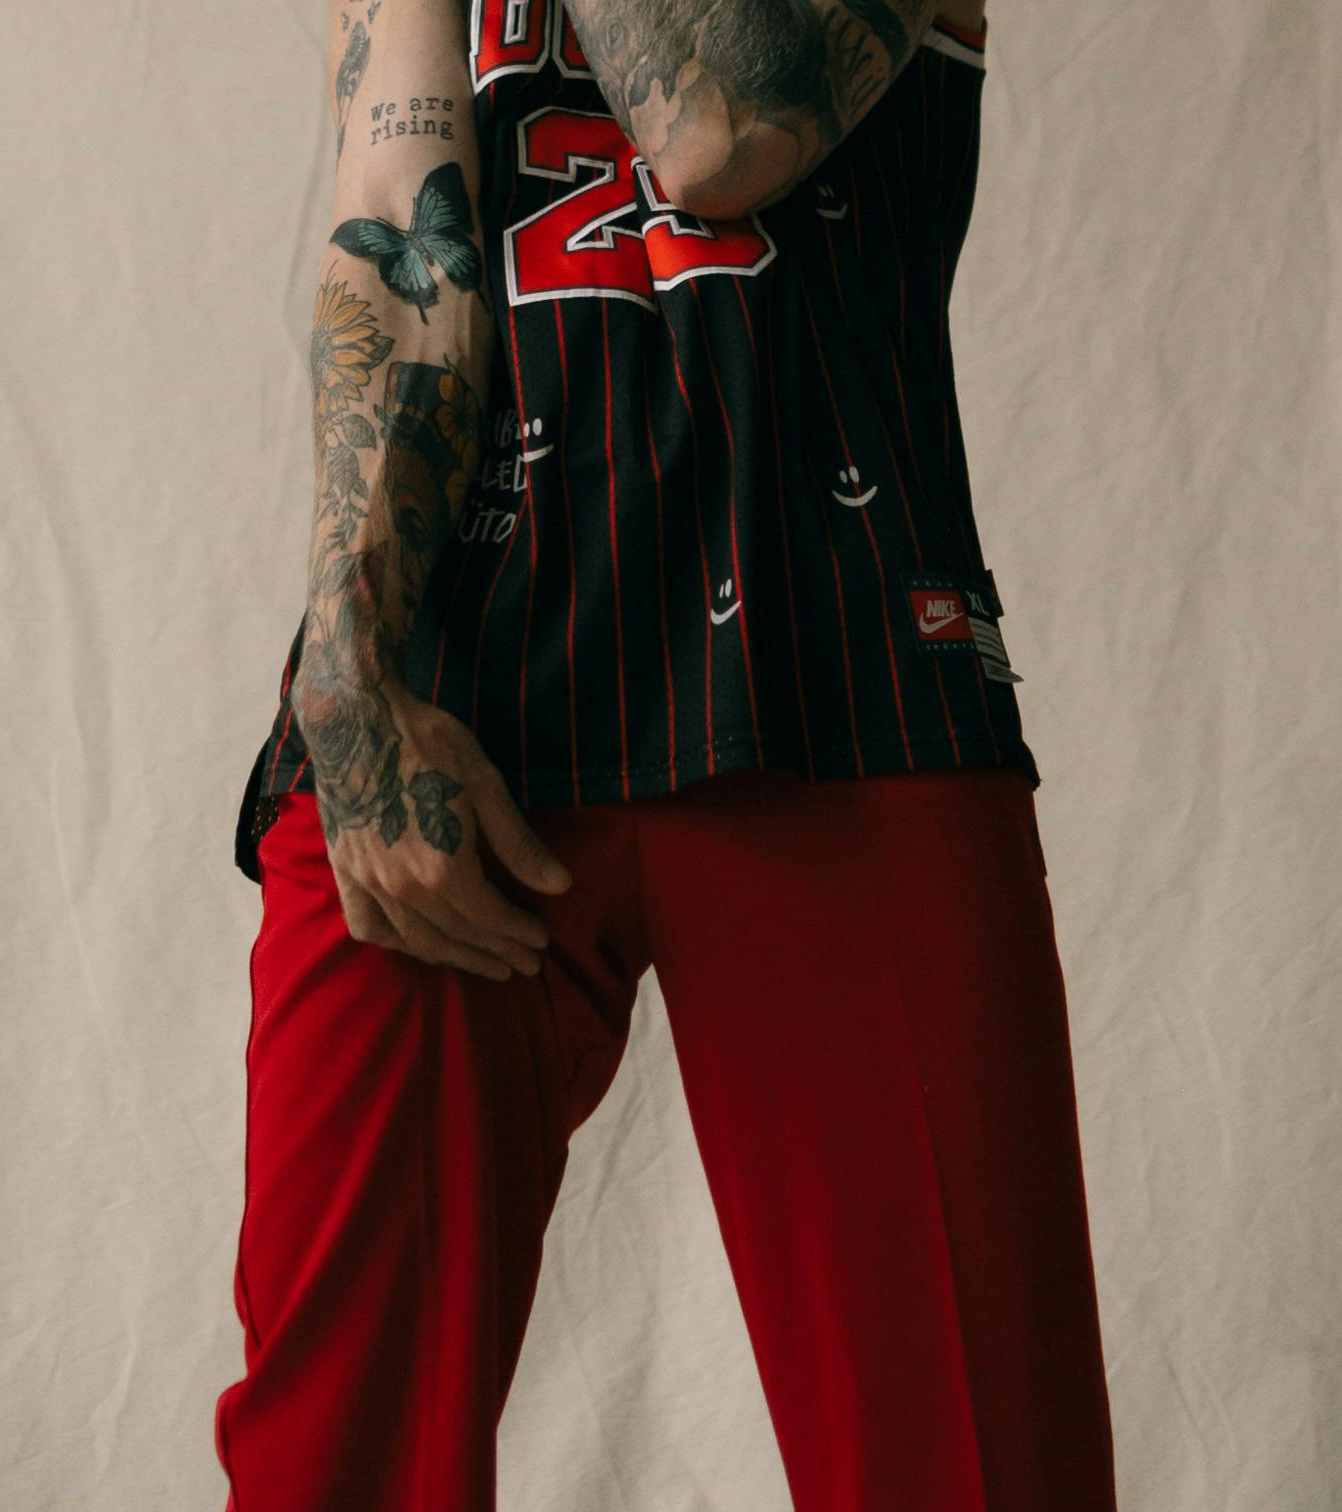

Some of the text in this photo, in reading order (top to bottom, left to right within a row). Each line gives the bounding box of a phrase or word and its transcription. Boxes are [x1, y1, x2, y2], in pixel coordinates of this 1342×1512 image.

[409, 97, 454, 112] are
[370, 115, 454, 146] rising
[926, 599, 956, 618] NIKE
[964, 589, 991, 616] XL
